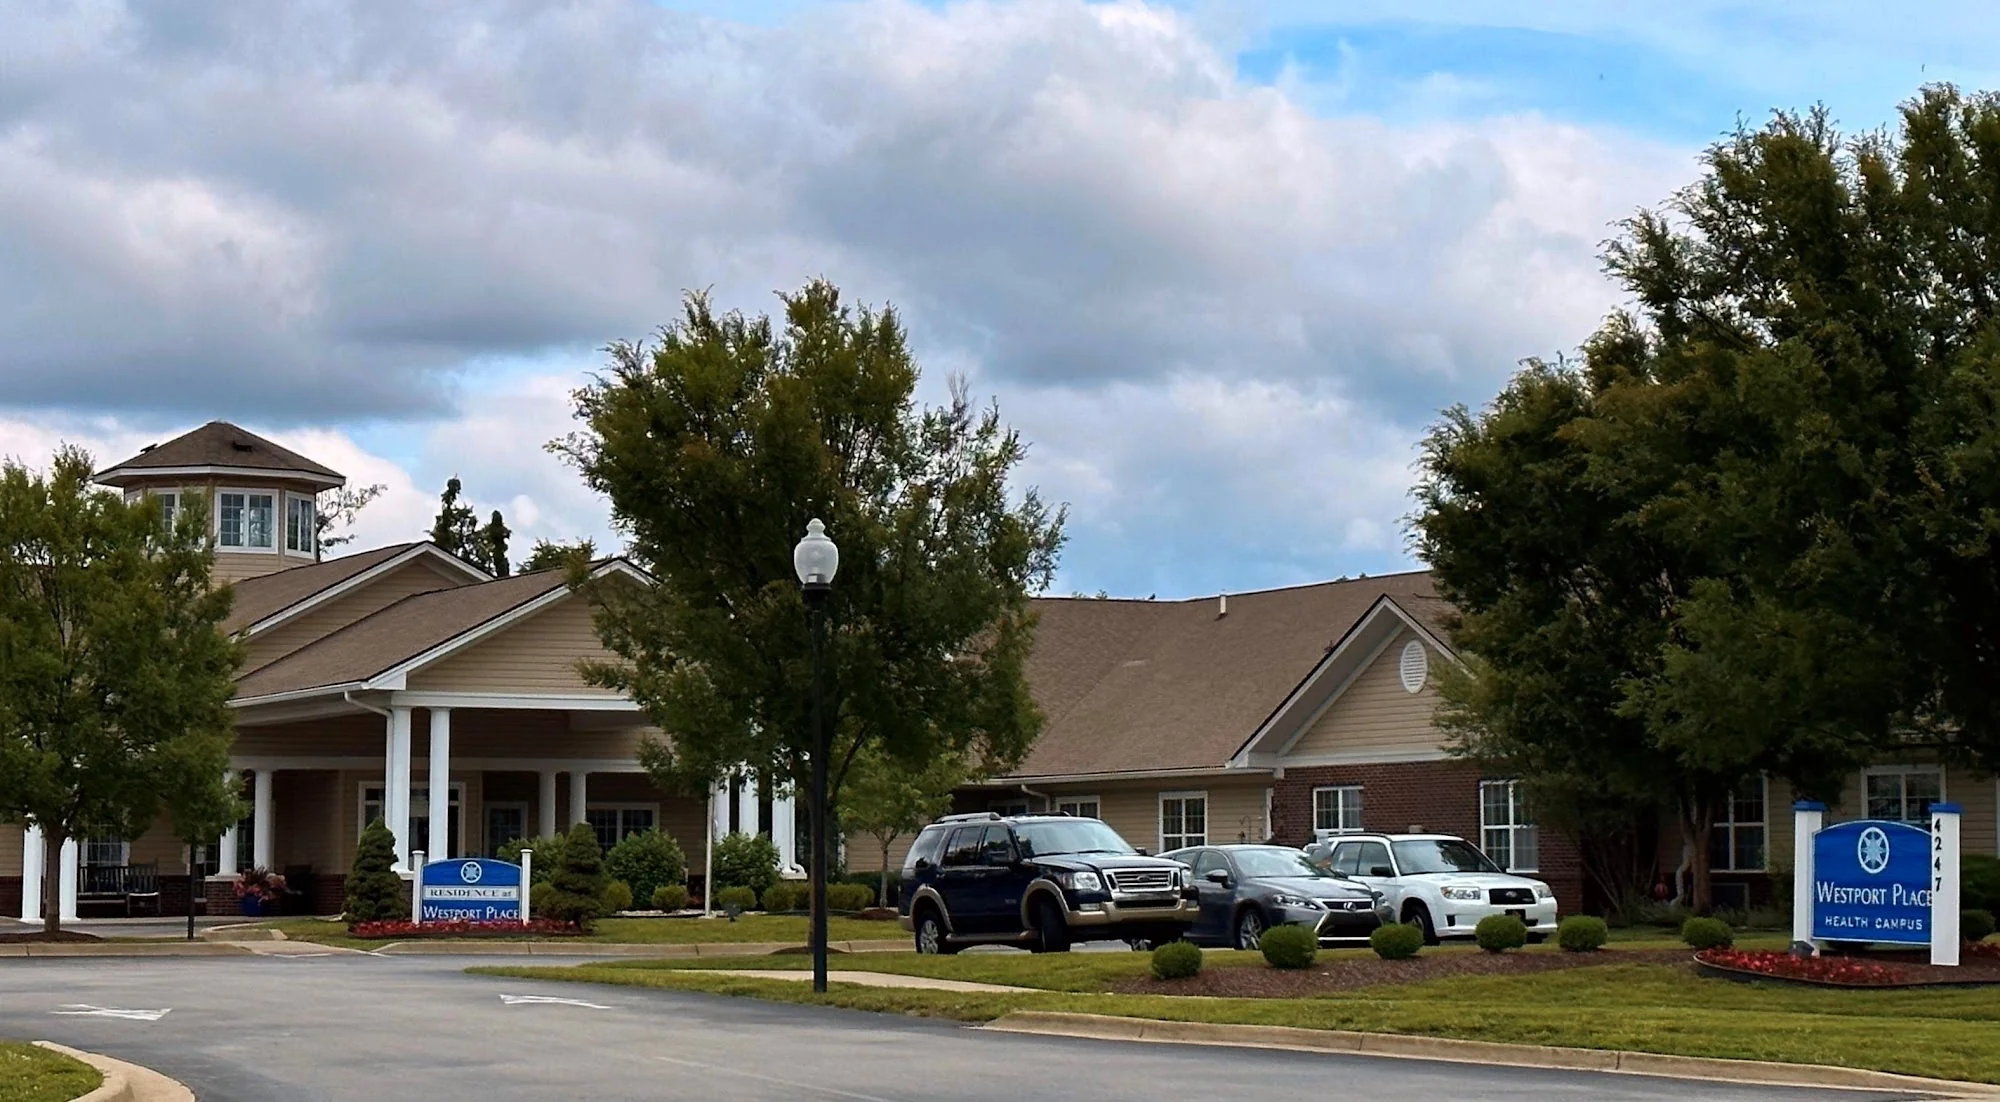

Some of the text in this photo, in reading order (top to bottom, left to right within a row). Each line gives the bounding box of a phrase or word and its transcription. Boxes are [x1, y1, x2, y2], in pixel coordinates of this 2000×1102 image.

[1934, 818, 1942, 892] 4247
[430, 889, 499, 897] RESIDENCE
[1816, 880, 1932, 907] WESTPORT PLACE
[423, 905, 519, 920] WESTPORT PLACE
[1825, 916, 1923, 930] HEALTH CAMPUS
